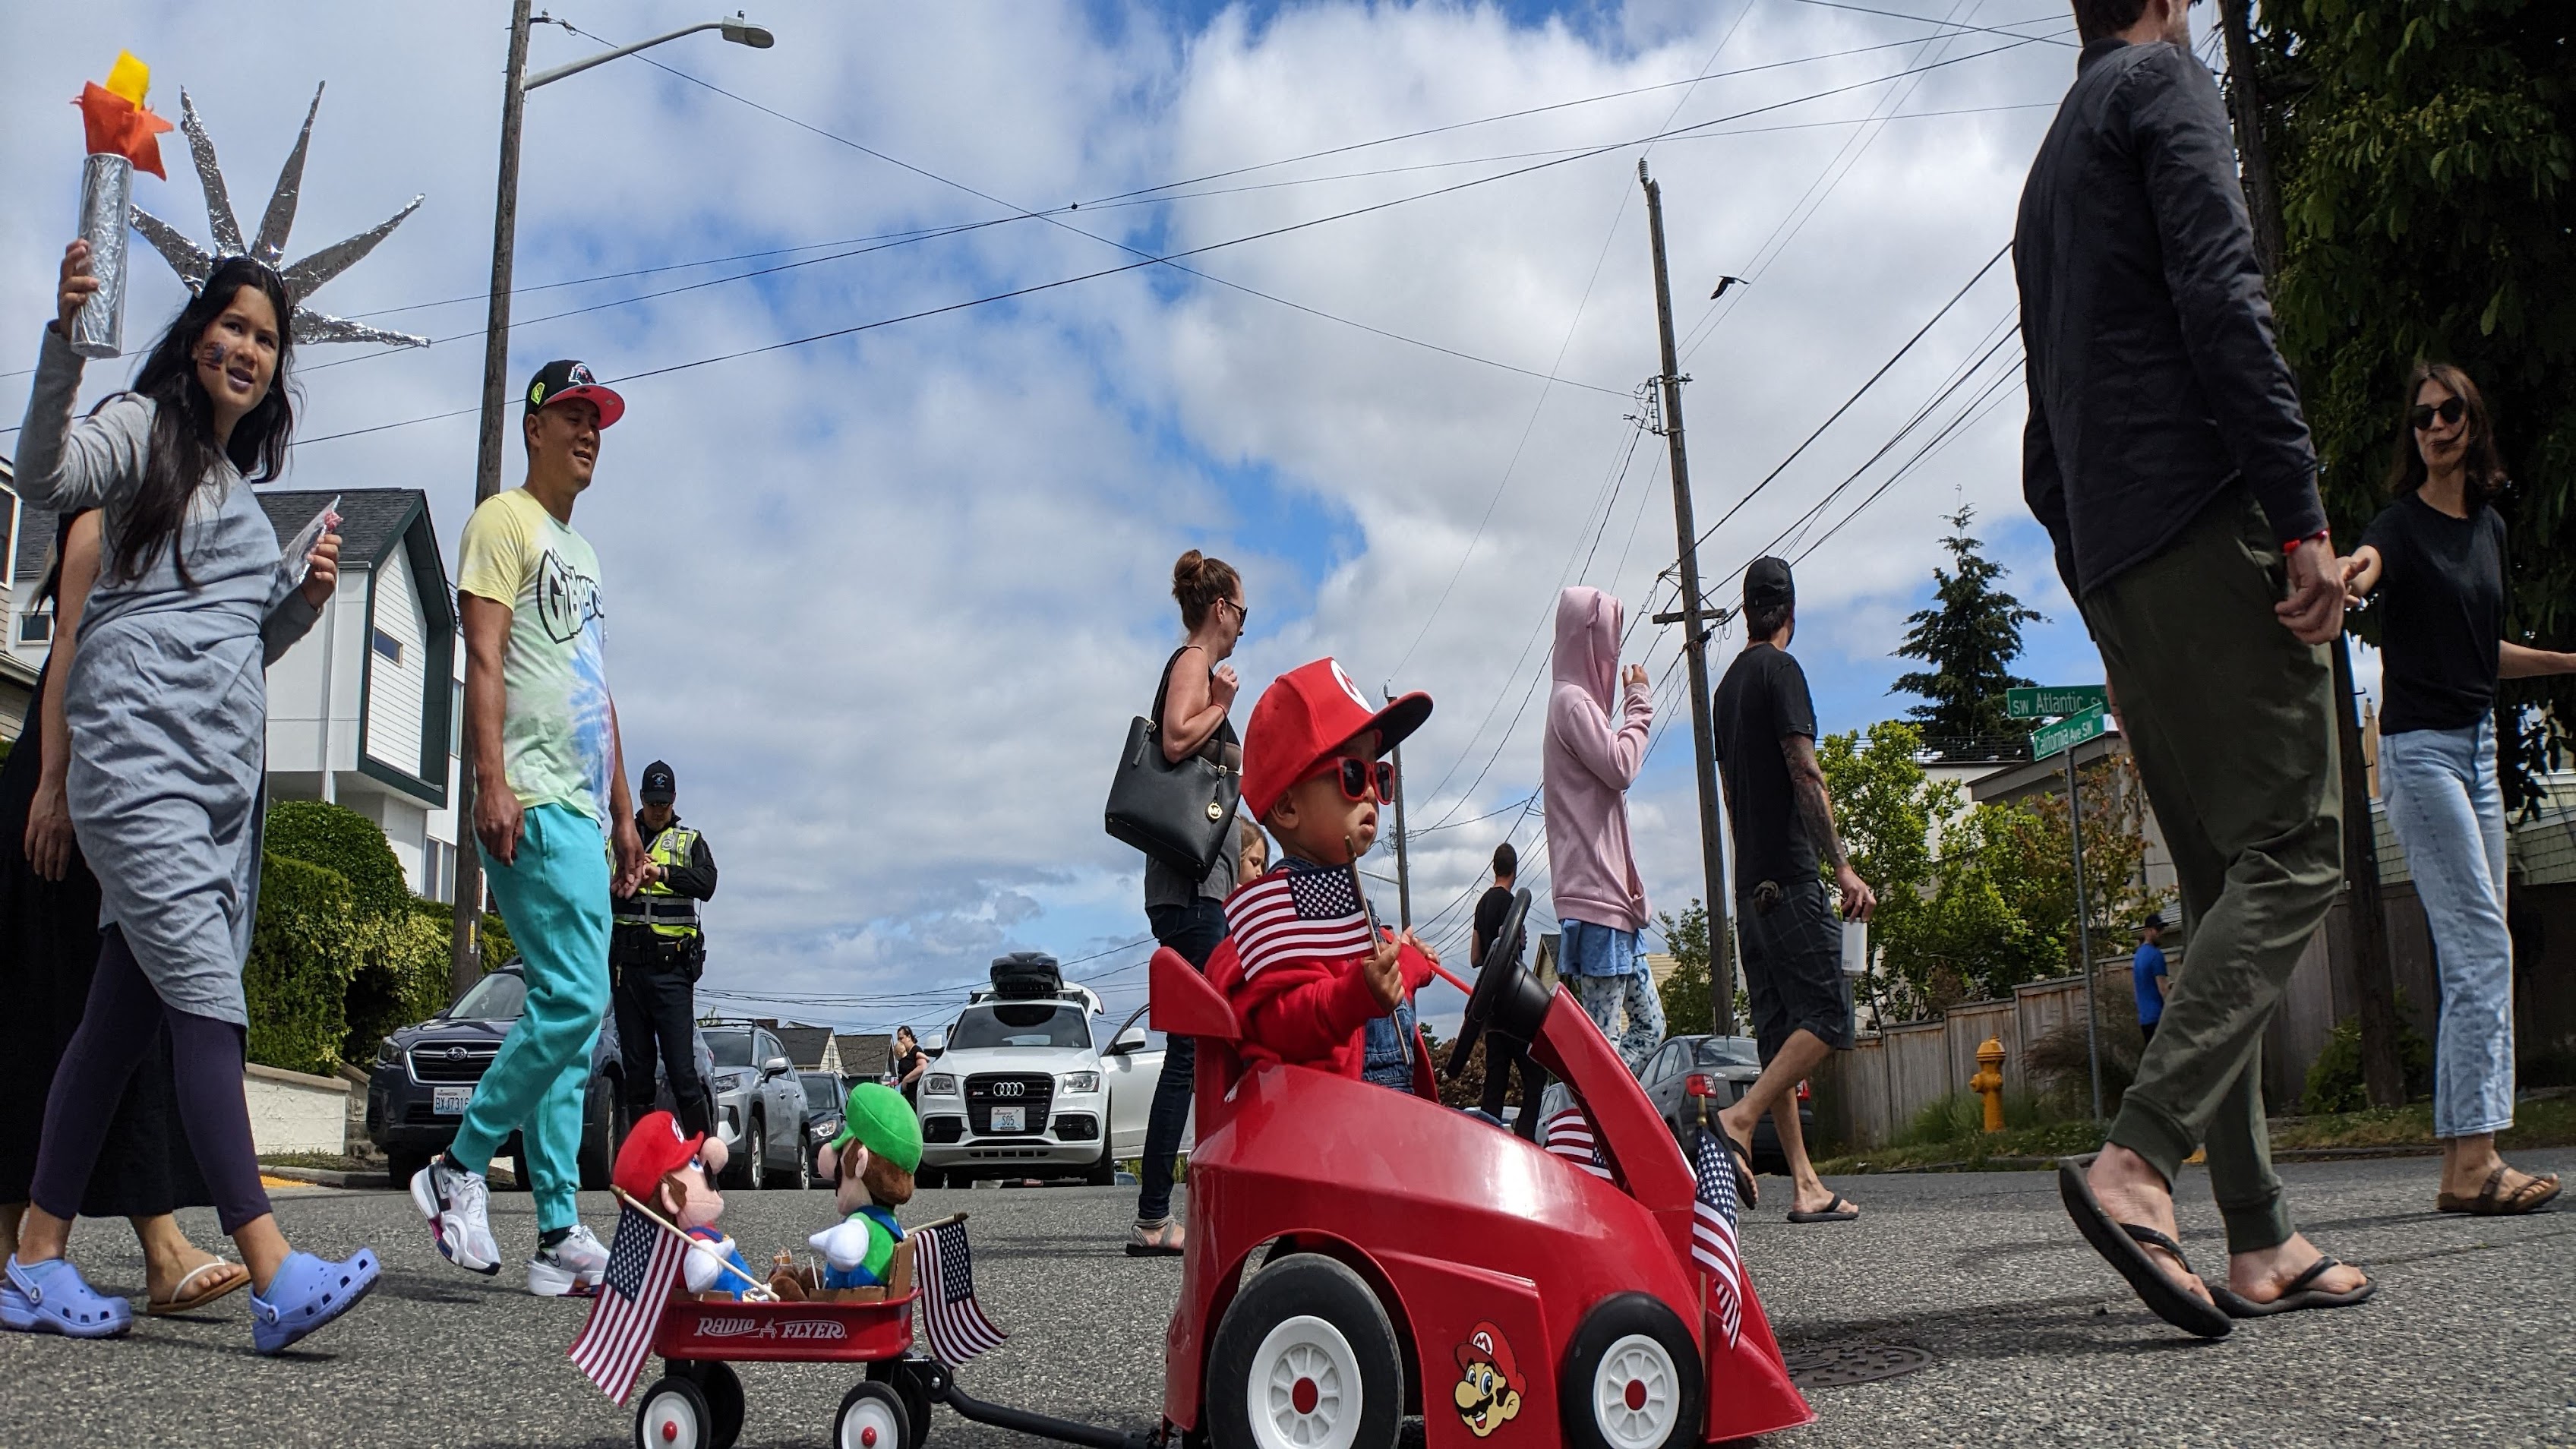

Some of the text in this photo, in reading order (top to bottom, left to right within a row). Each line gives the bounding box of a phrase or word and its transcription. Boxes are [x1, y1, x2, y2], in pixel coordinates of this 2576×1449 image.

[2012, 699, 2029, 715] SW
[2036, 691, 2084, 714] Atlantic
[2035, 719, 2094, 756] California Ave SW
[1002, 1115, 1015, 1125] SQ5
[693, 1318, 846, 1339] RADIO FLYER
[1475, 1334, 1492, 1352] M
